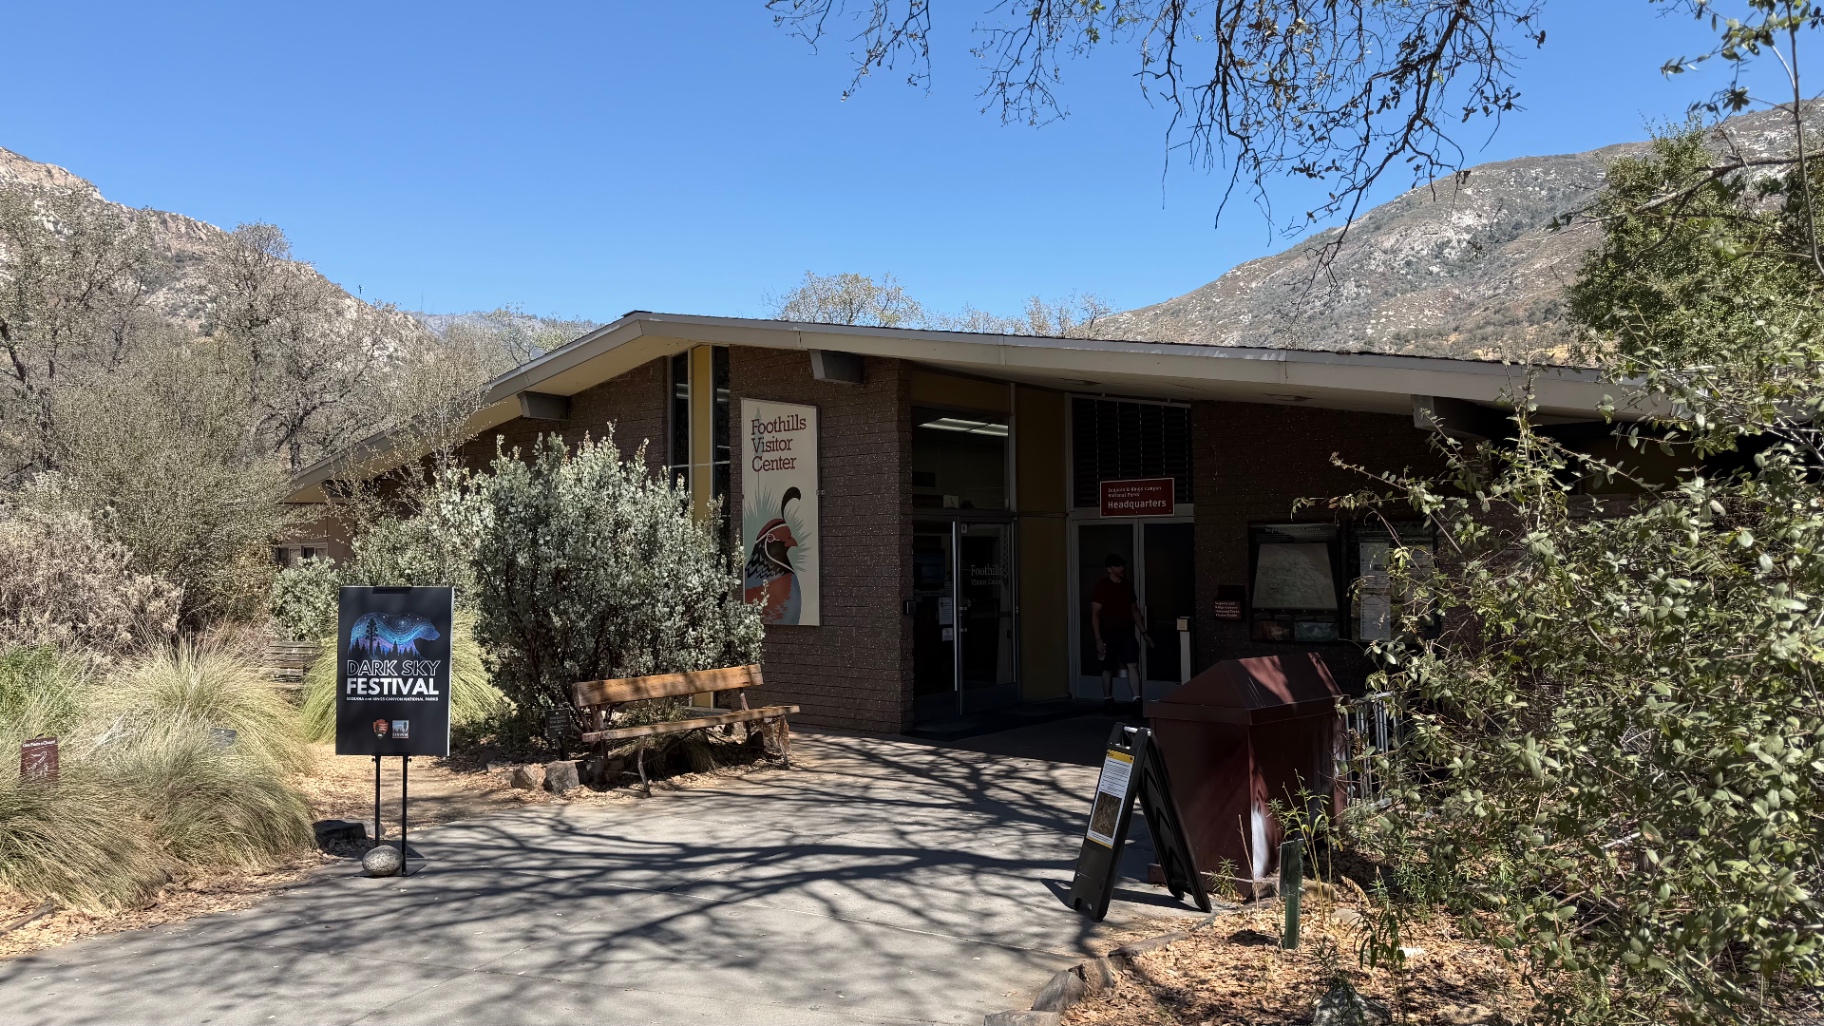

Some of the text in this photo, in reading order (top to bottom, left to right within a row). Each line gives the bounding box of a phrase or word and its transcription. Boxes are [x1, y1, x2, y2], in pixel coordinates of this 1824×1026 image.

[751, 414, 807, 435] Foothills
[751, 435, 793, 453] Visitor
[752, 455, 797, 472] Center
[1107, 499, 1167, 510] Headquarters
[970, 563, 1003, 576] Foothills
[347, 660, 441, 676] DARK SKY
[346, 677, 440, 695] FESTIVAL
